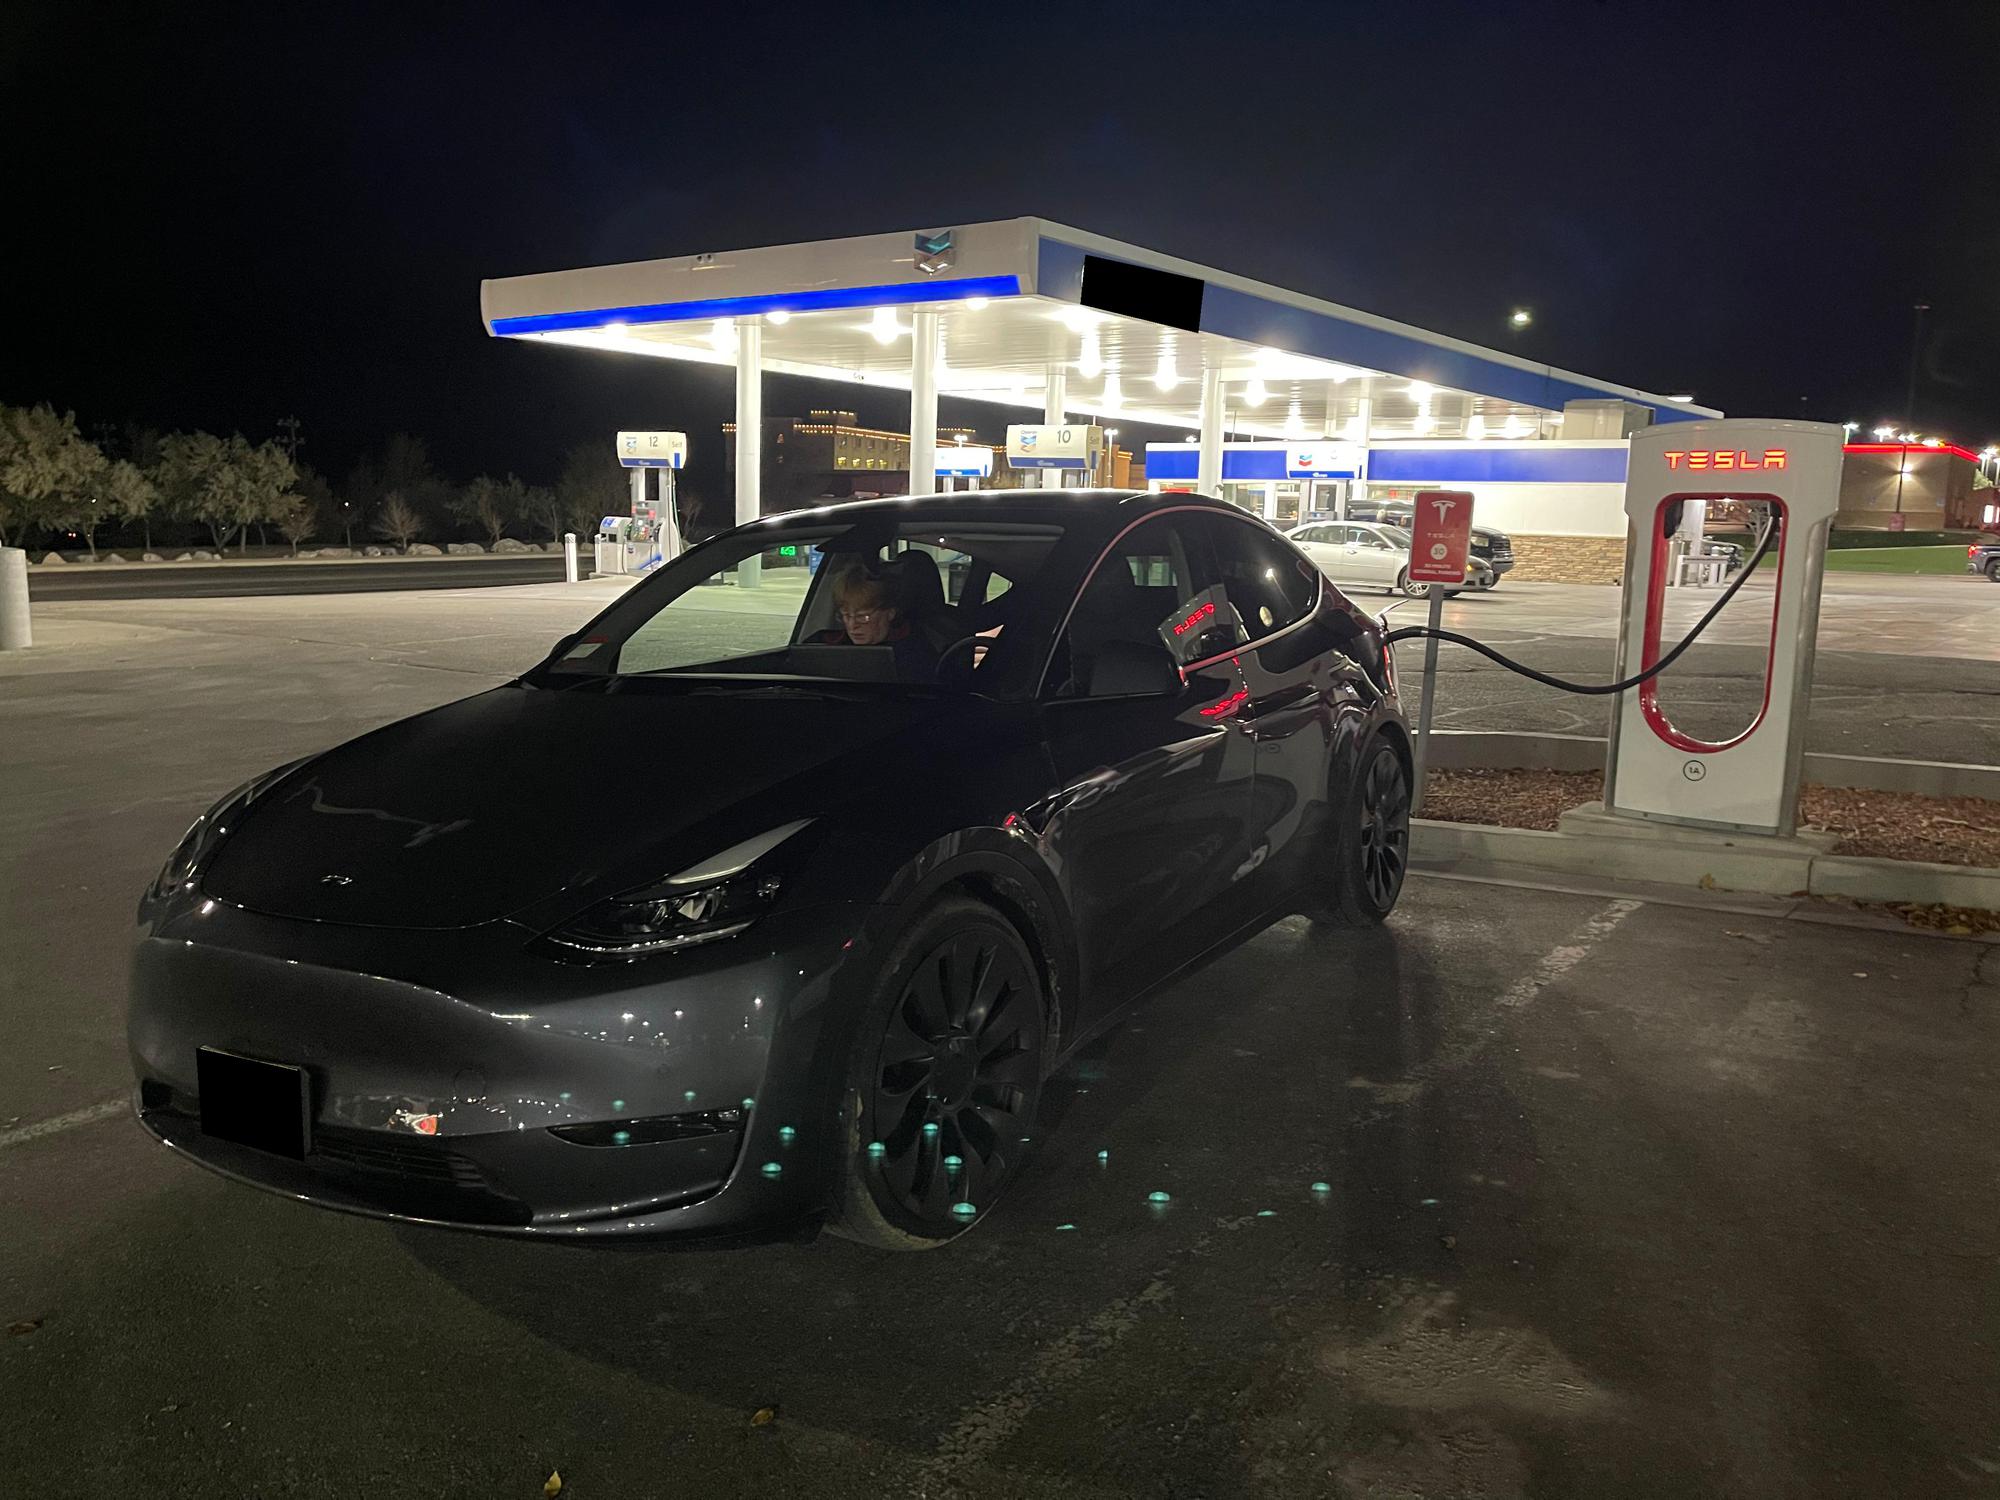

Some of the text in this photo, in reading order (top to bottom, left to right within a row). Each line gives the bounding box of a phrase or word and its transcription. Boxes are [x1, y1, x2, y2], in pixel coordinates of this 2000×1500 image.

[649, 436, 658, 447] 12
[1057, 430, 1071, 443] 10
[1664, 449, 1787, 470] TESLA
